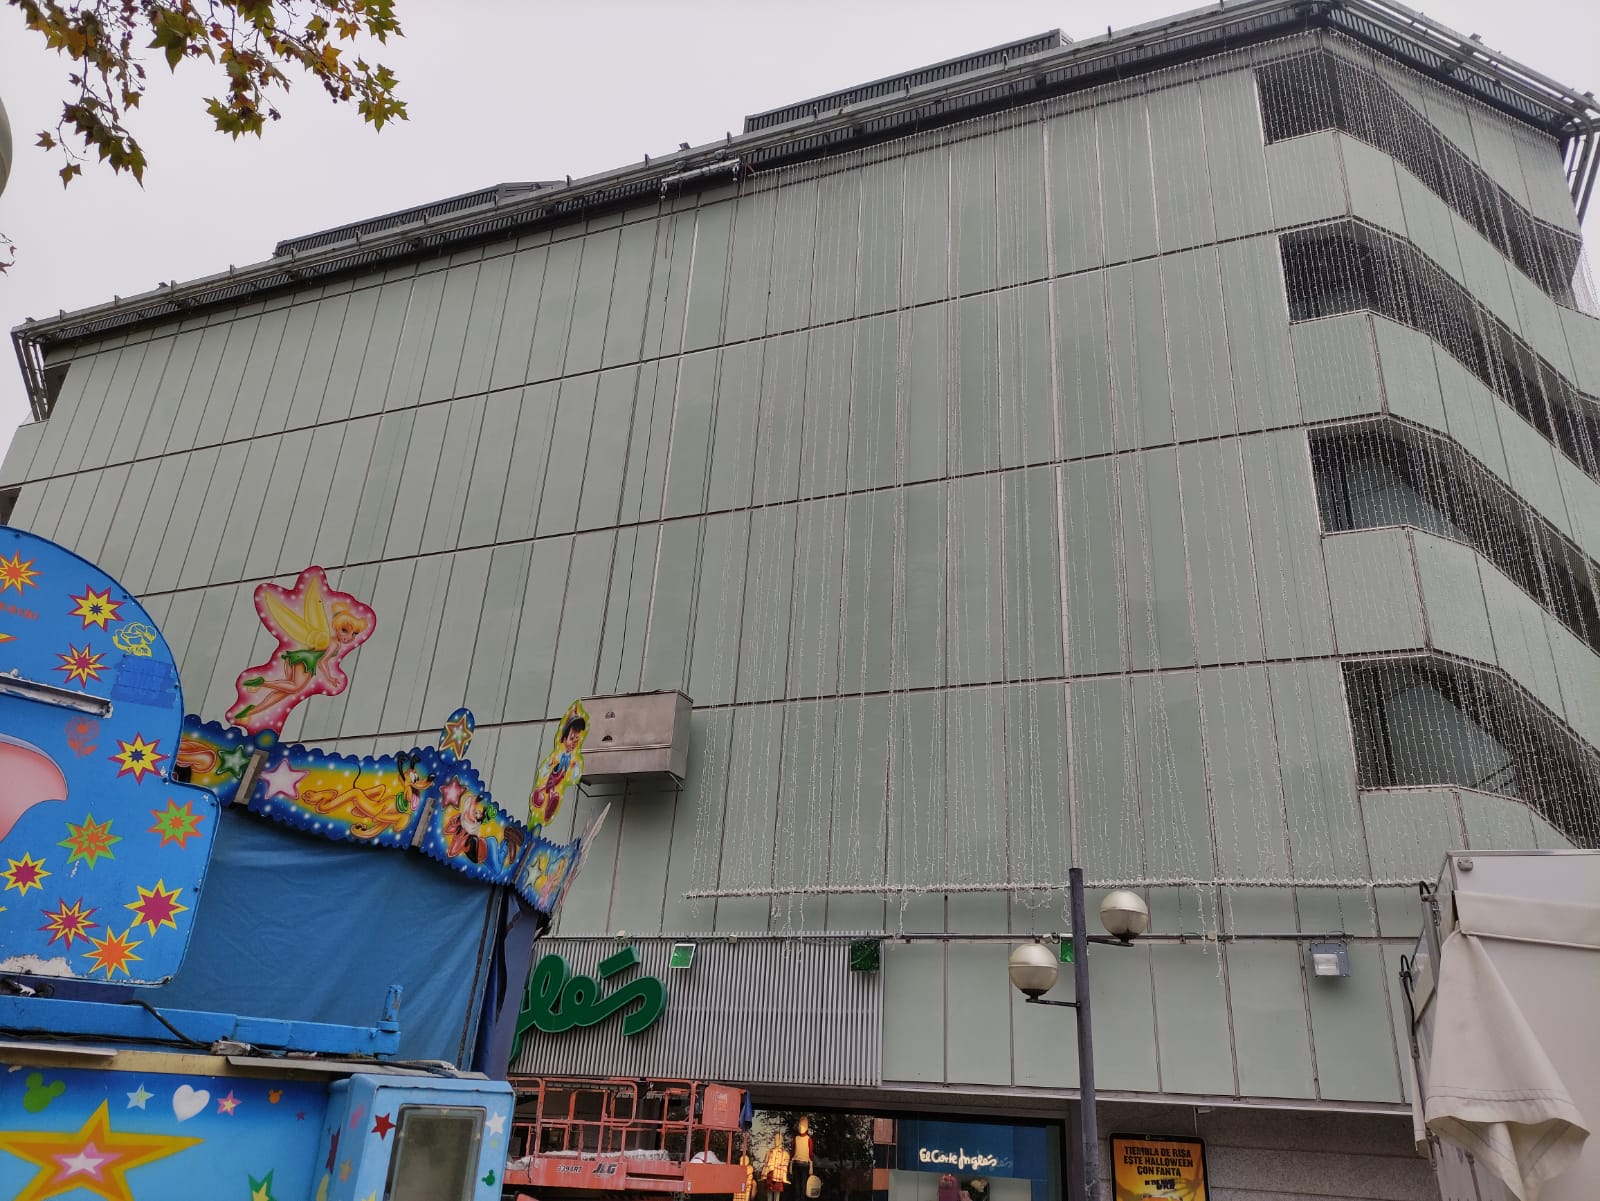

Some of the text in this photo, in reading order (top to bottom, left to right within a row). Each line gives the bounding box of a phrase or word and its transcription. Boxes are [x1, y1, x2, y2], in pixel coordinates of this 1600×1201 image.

[1124, 1146, 1192, 1158] TIEMBLA DE RISA
[1123, 1156, 1194, 1168] ESTE HALLOWEEN
[1137, 1166, 1181, 1177] CON FANTA
